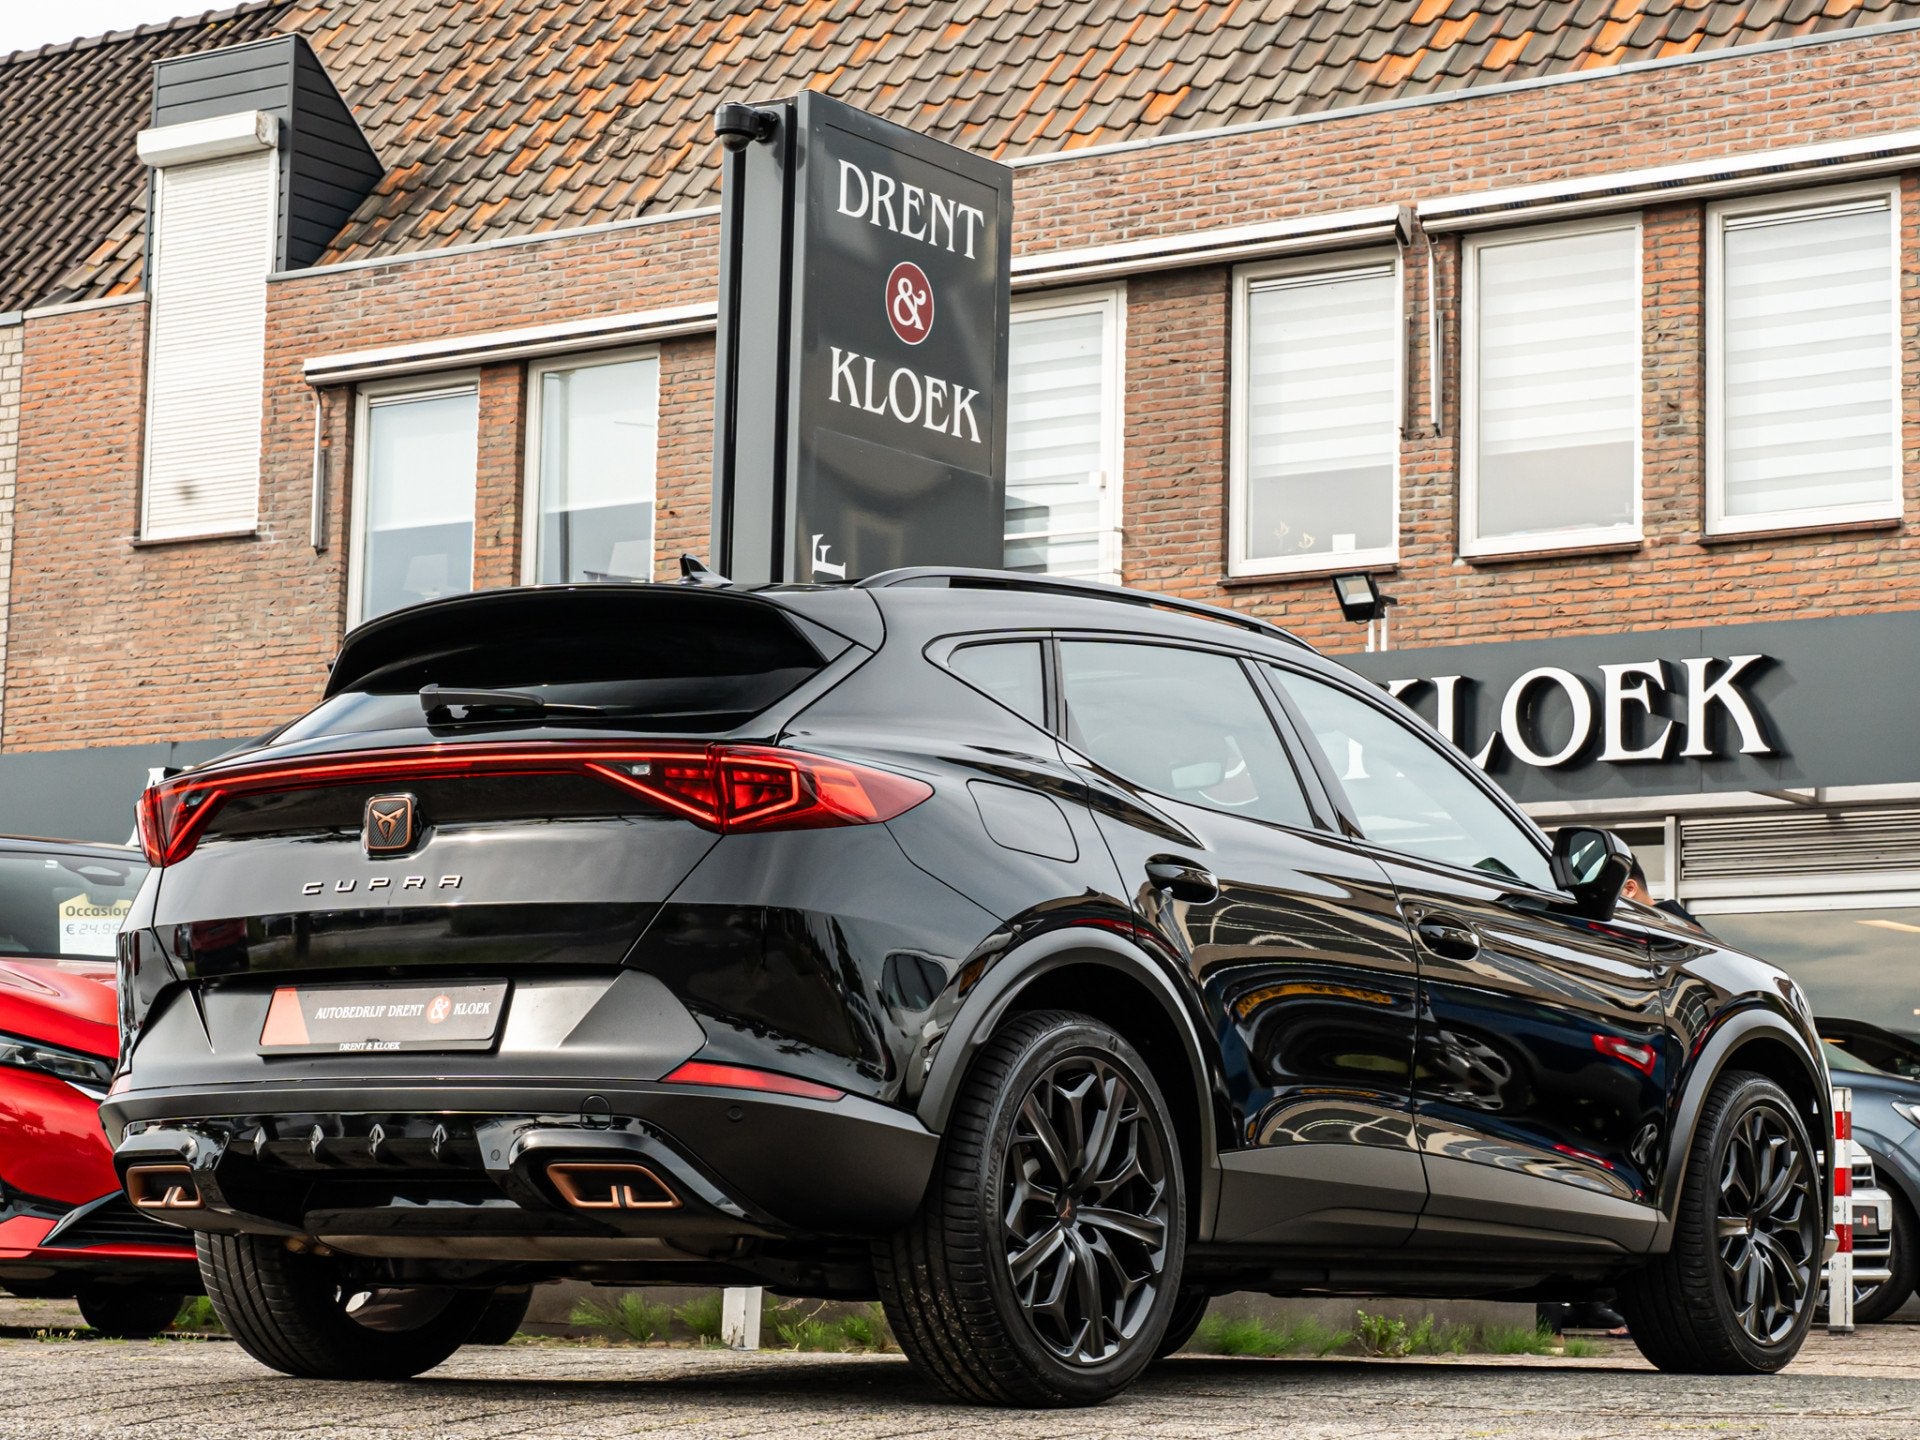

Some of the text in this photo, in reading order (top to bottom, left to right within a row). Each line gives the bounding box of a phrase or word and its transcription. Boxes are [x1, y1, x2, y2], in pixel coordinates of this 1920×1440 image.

[837, 159, 985, 260] DRENT
[893, 277, 926, 331] &
[829, 346, 982, 443] KLOEK
[302, 874, 463, 895] CUPRA
[315, 998, 492, 1019] AUTOBEDRIJF DRENT & KLOEK
[339, 1042, 367, 1051] DRENT
[373, 1041, 401, 1050] KLOEK
